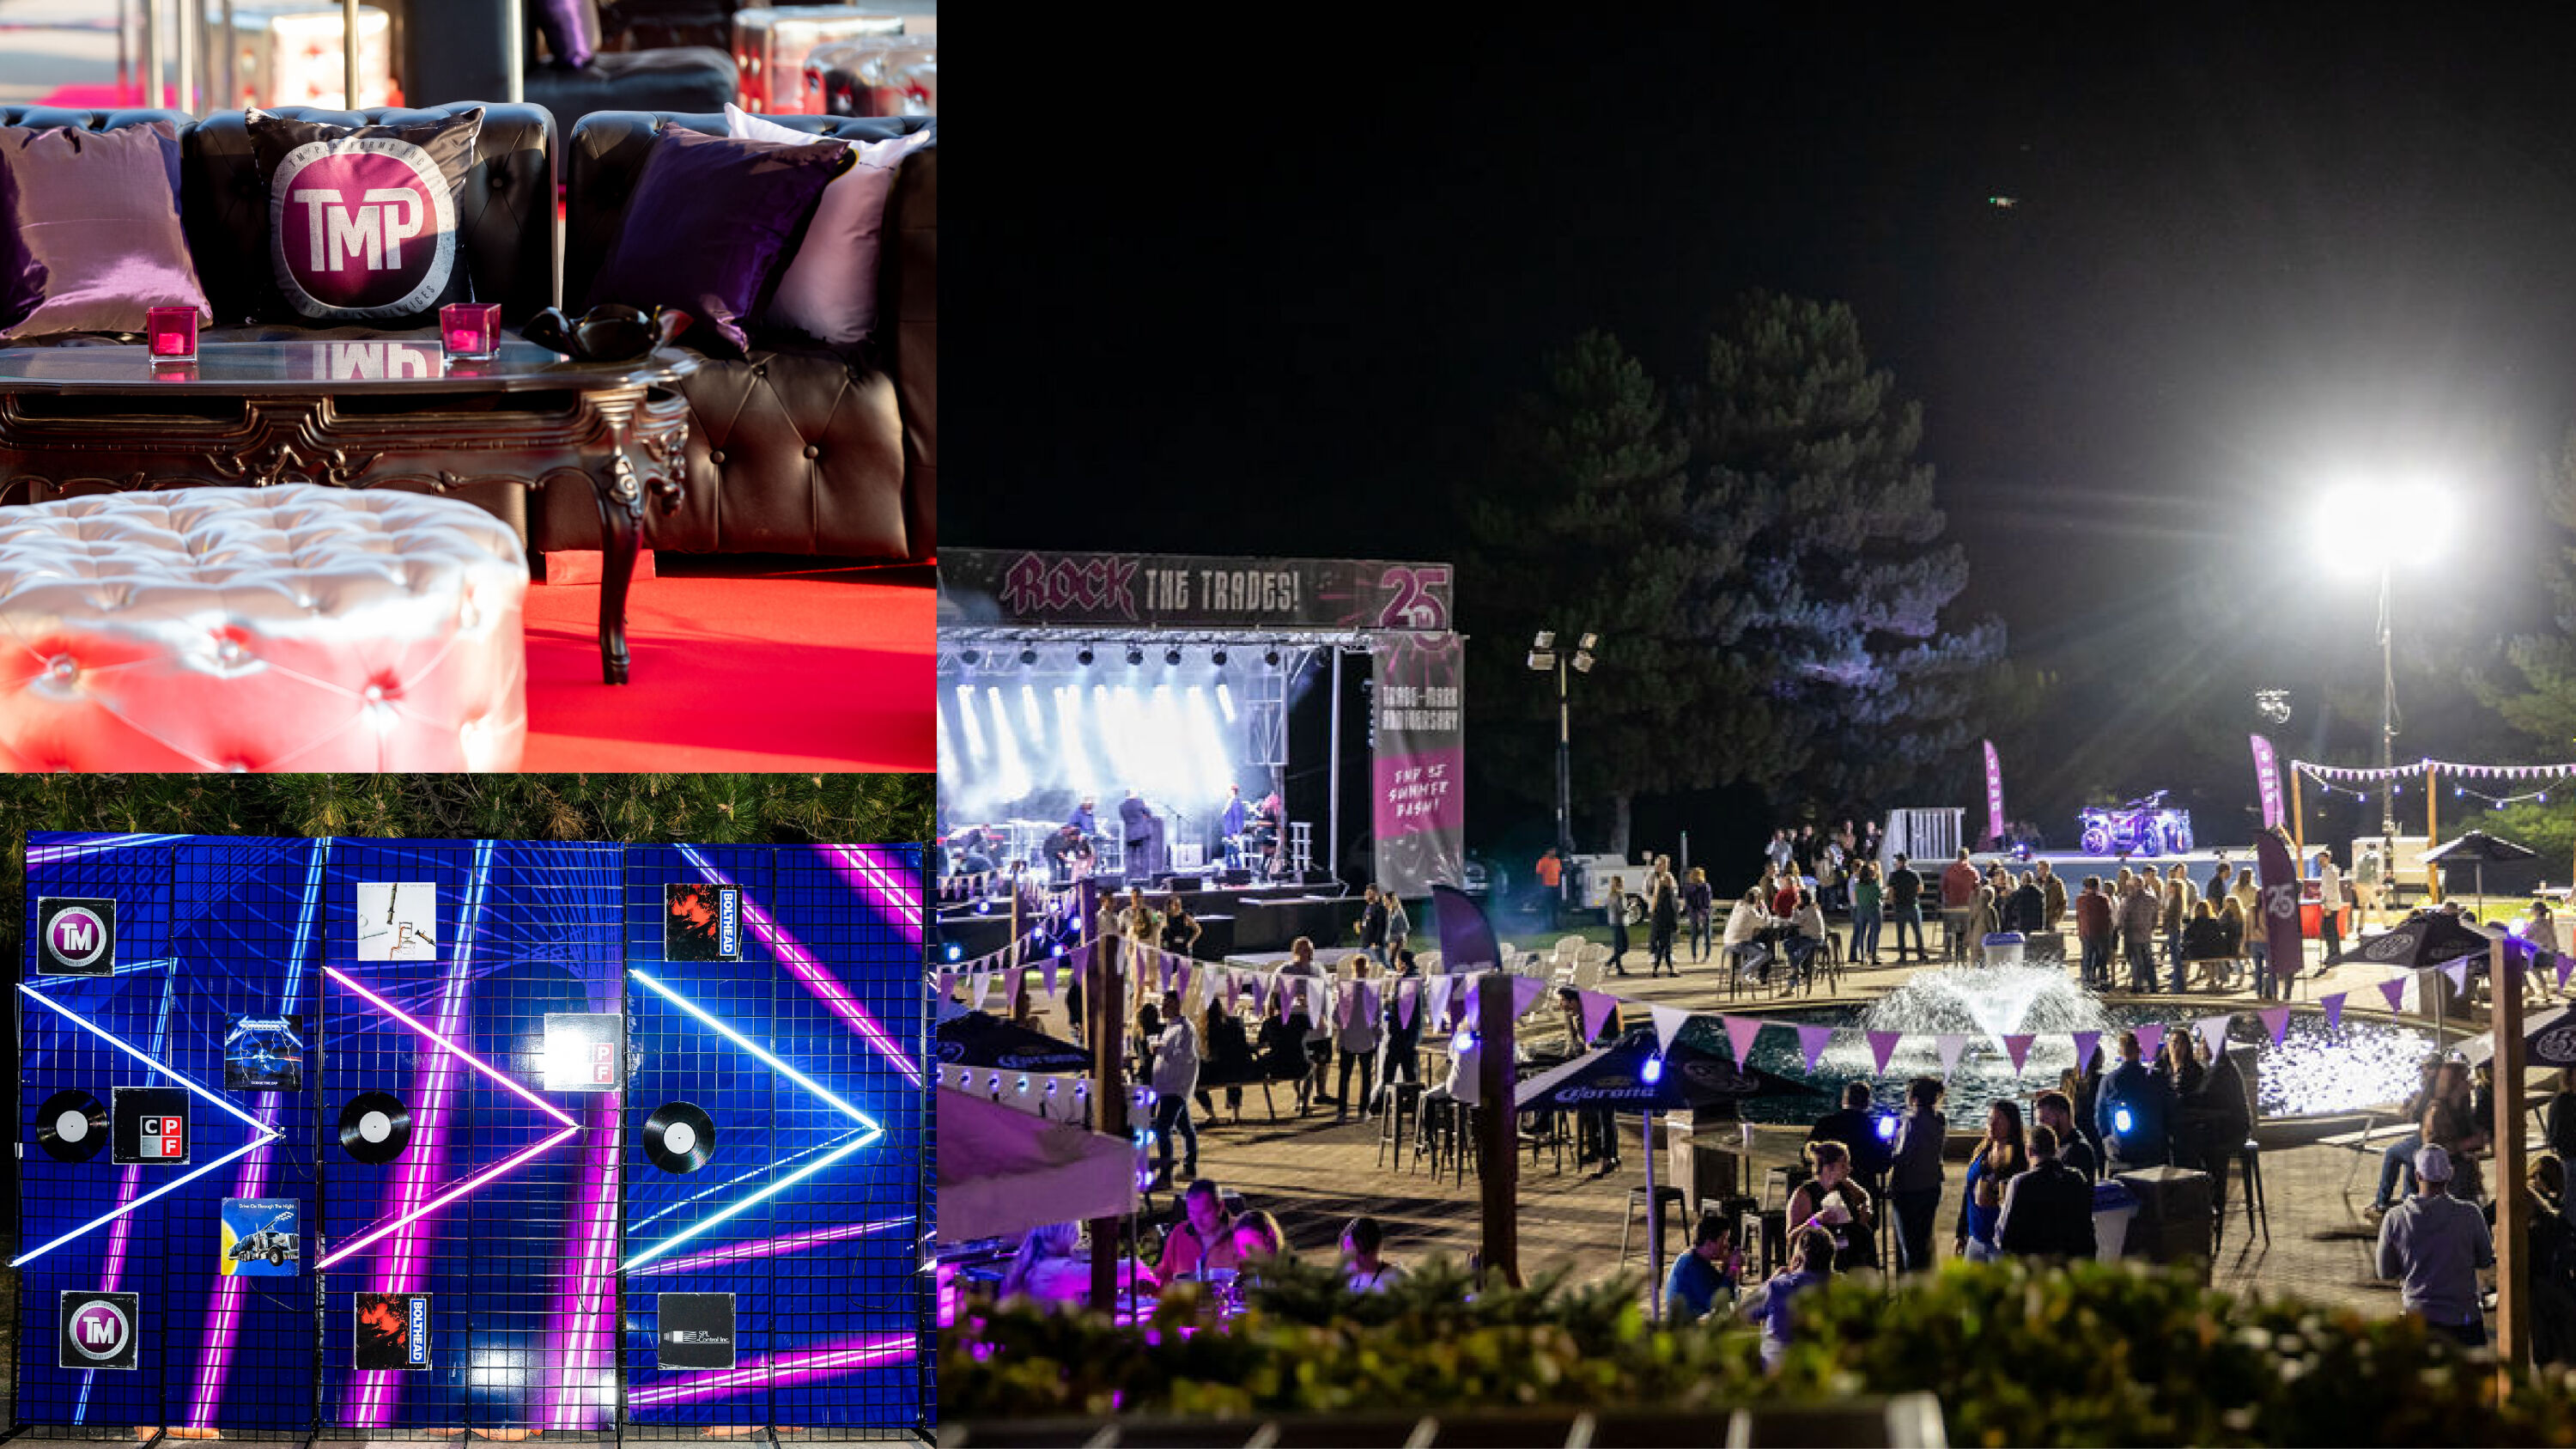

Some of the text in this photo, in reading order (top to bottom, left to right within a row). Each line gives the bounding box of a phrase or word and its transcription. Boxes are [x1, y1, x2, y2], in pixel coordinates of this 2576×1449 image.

[403, 148, 424, 166] INC
[294, 187, 423, 271] TMP
[1145, 569, 1189, 612] THE
[1200, 569, 1300, 612] TRADES!
[1378, 566, 1451, 650] 25
[2267, 884, 2295, 919] 25
[60, 922, 92, 951] TM
[723, 893, 733, 953] BOLTHEAD
[598, 1046, 610, 1061] P
[598, 1066, 609, 1081] F
[1554, 1086, 1656, 1103] Corona
[82, 1316, 115, 1344] TM
[413, 1301, 423, 1361] BOLTHEAD
